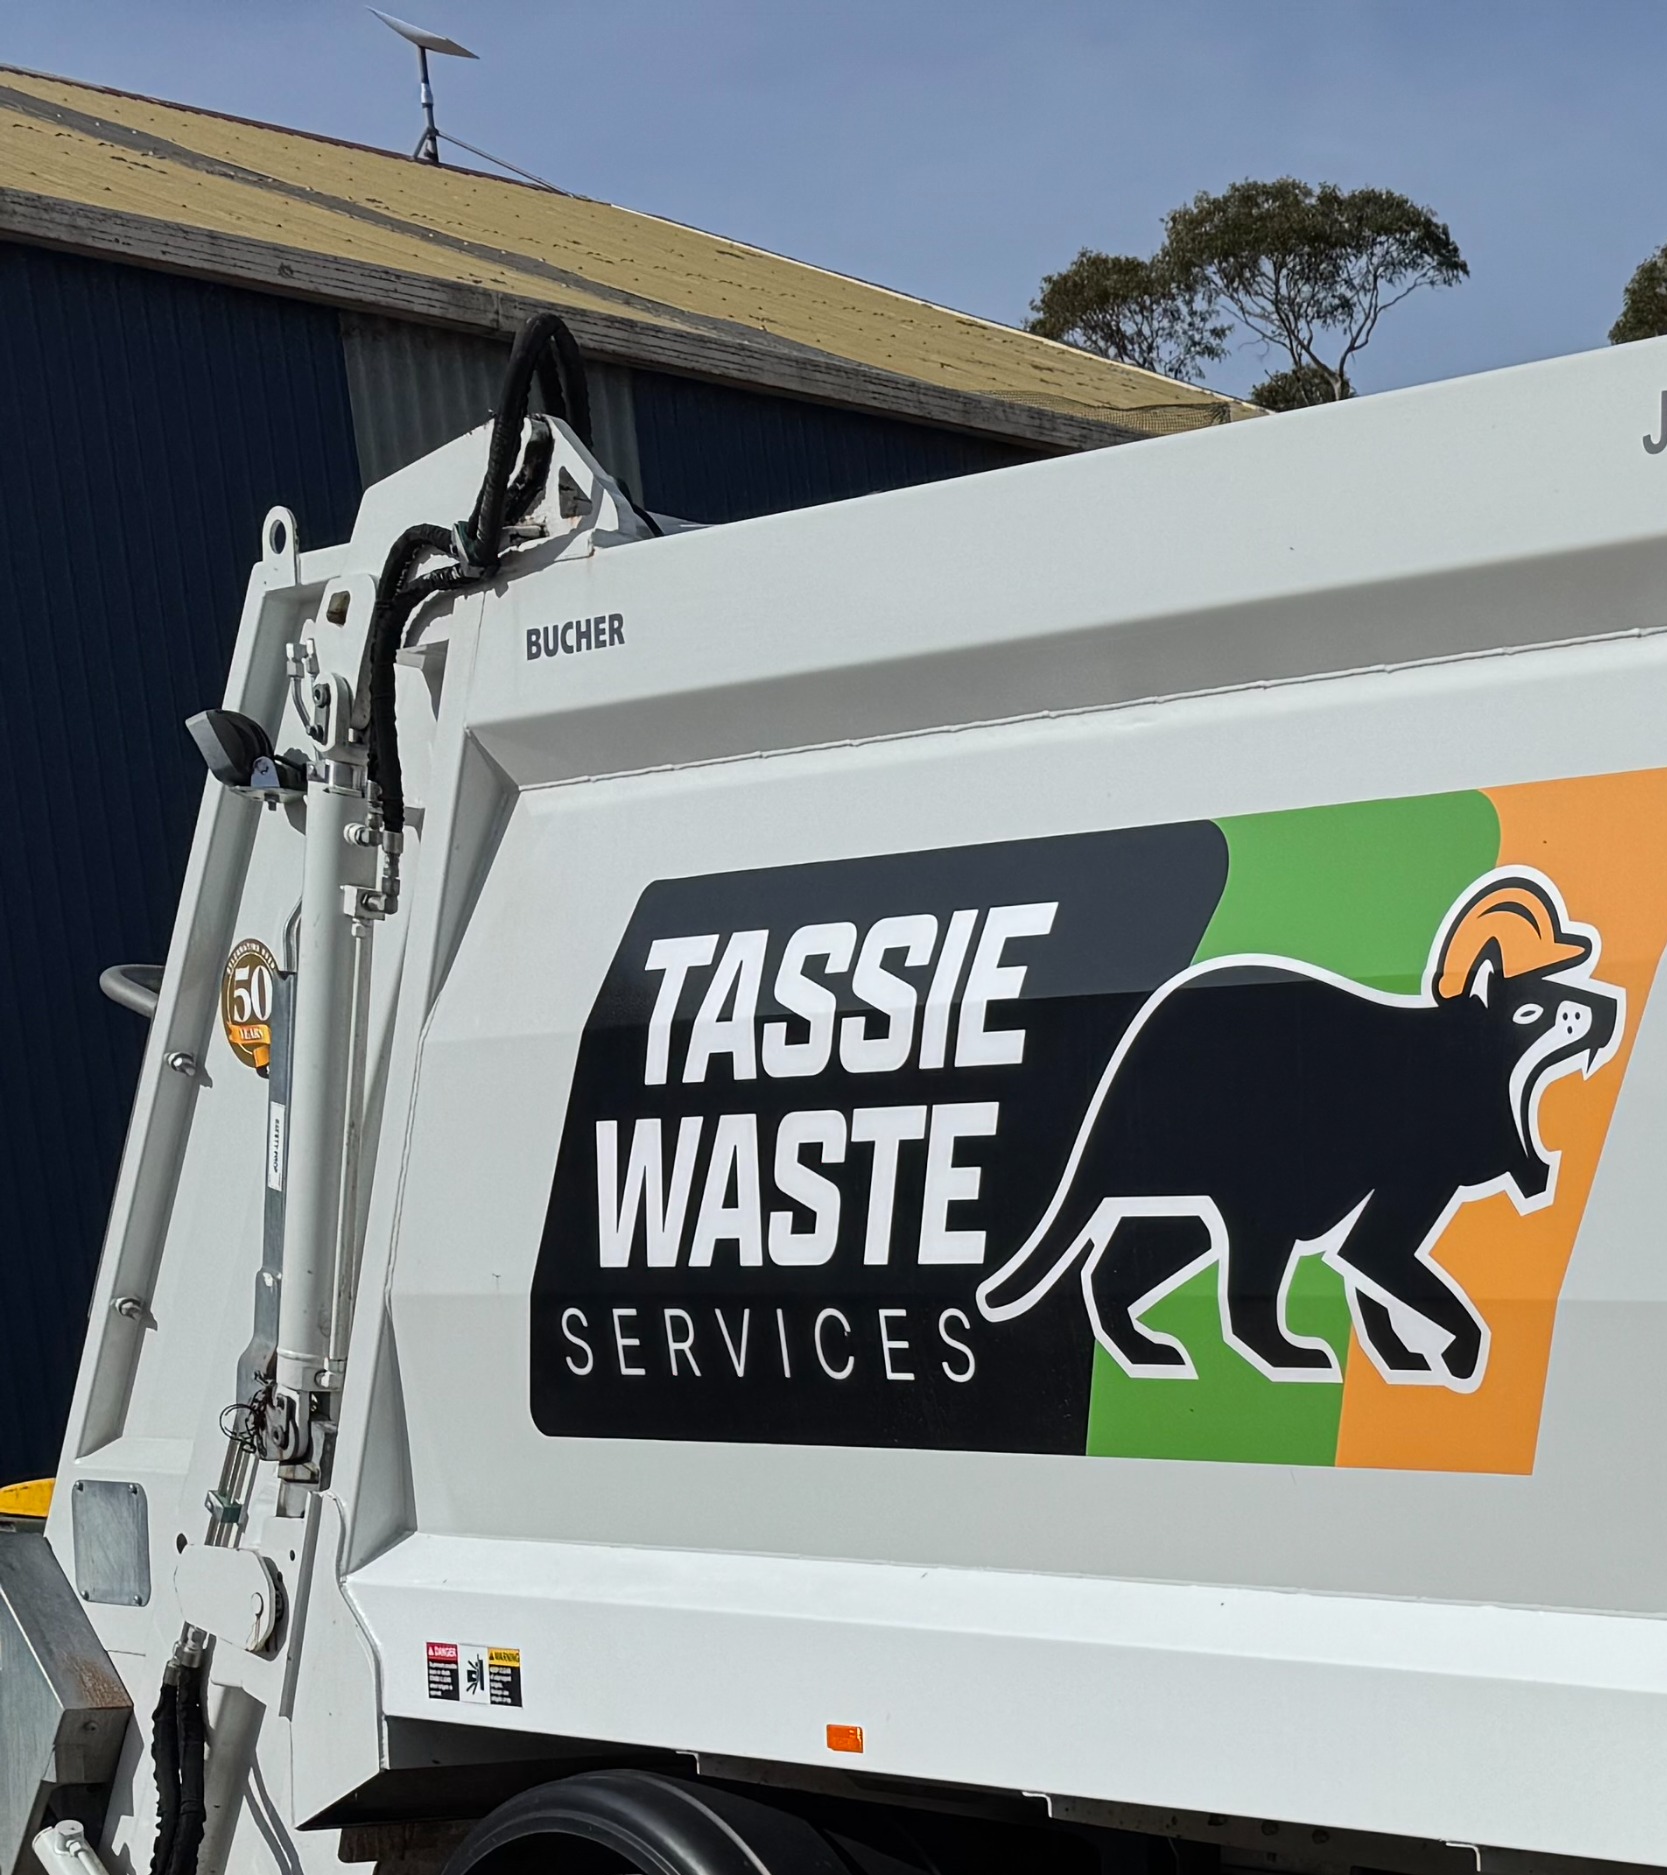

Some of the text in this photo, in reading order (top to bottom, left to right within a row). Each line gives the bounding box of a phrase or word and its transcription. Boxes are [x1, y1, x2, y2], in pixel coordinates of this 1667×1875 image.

[526, 613, 625, 661] BUCHER
[233, 965, 273, 1022] 50
[643, 901, 1059, 1085] TASSIE
[595, 1101, 999, 1269] WASTE
[561, 1306, 976, 1384] SERVICES
